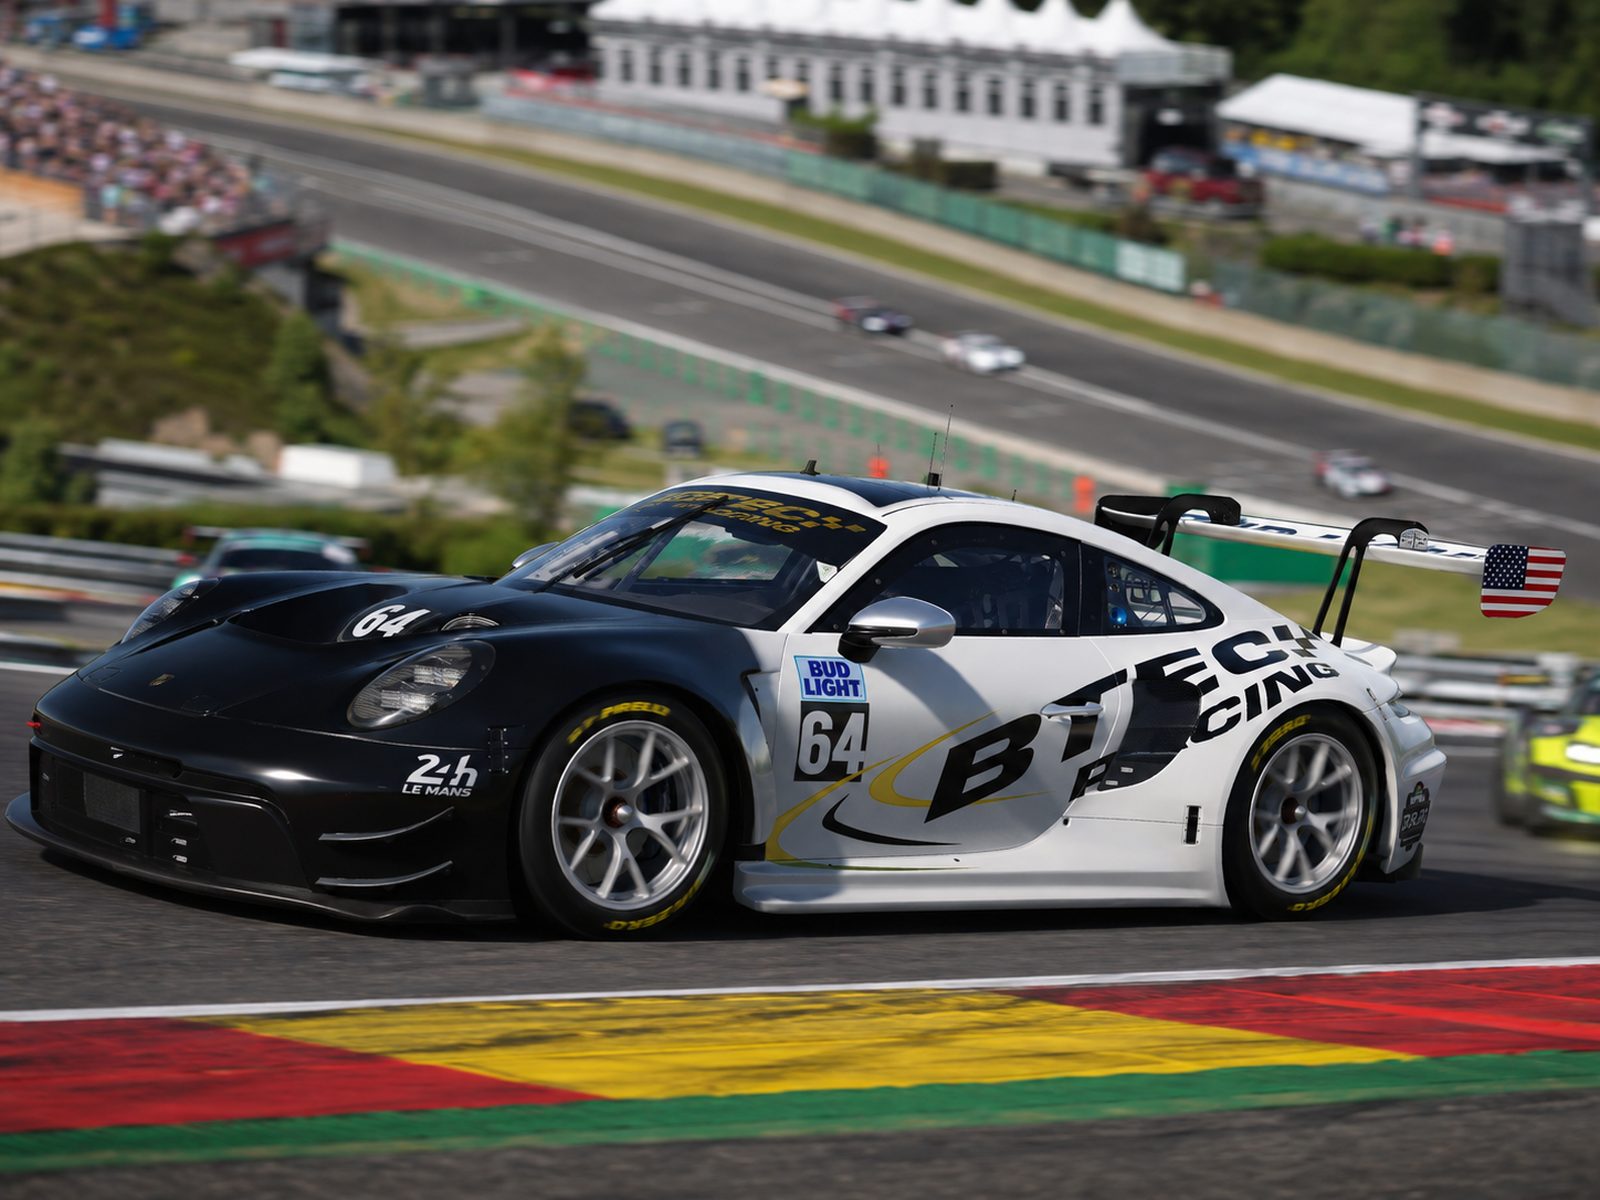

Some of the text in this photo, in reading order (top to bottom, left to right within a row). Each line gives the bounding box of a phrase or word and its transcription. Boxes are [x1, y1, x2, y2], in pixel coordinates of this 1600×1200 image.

[352, 604, 431, 638] 64
[808, 660, 851, 678] BUD
[803, 678, 861, 697] LIGHT
[798, 710, 866, 775] 64
[406, 753, 479, 787] 24h
[401, 784, 472, 798] LE MANS
